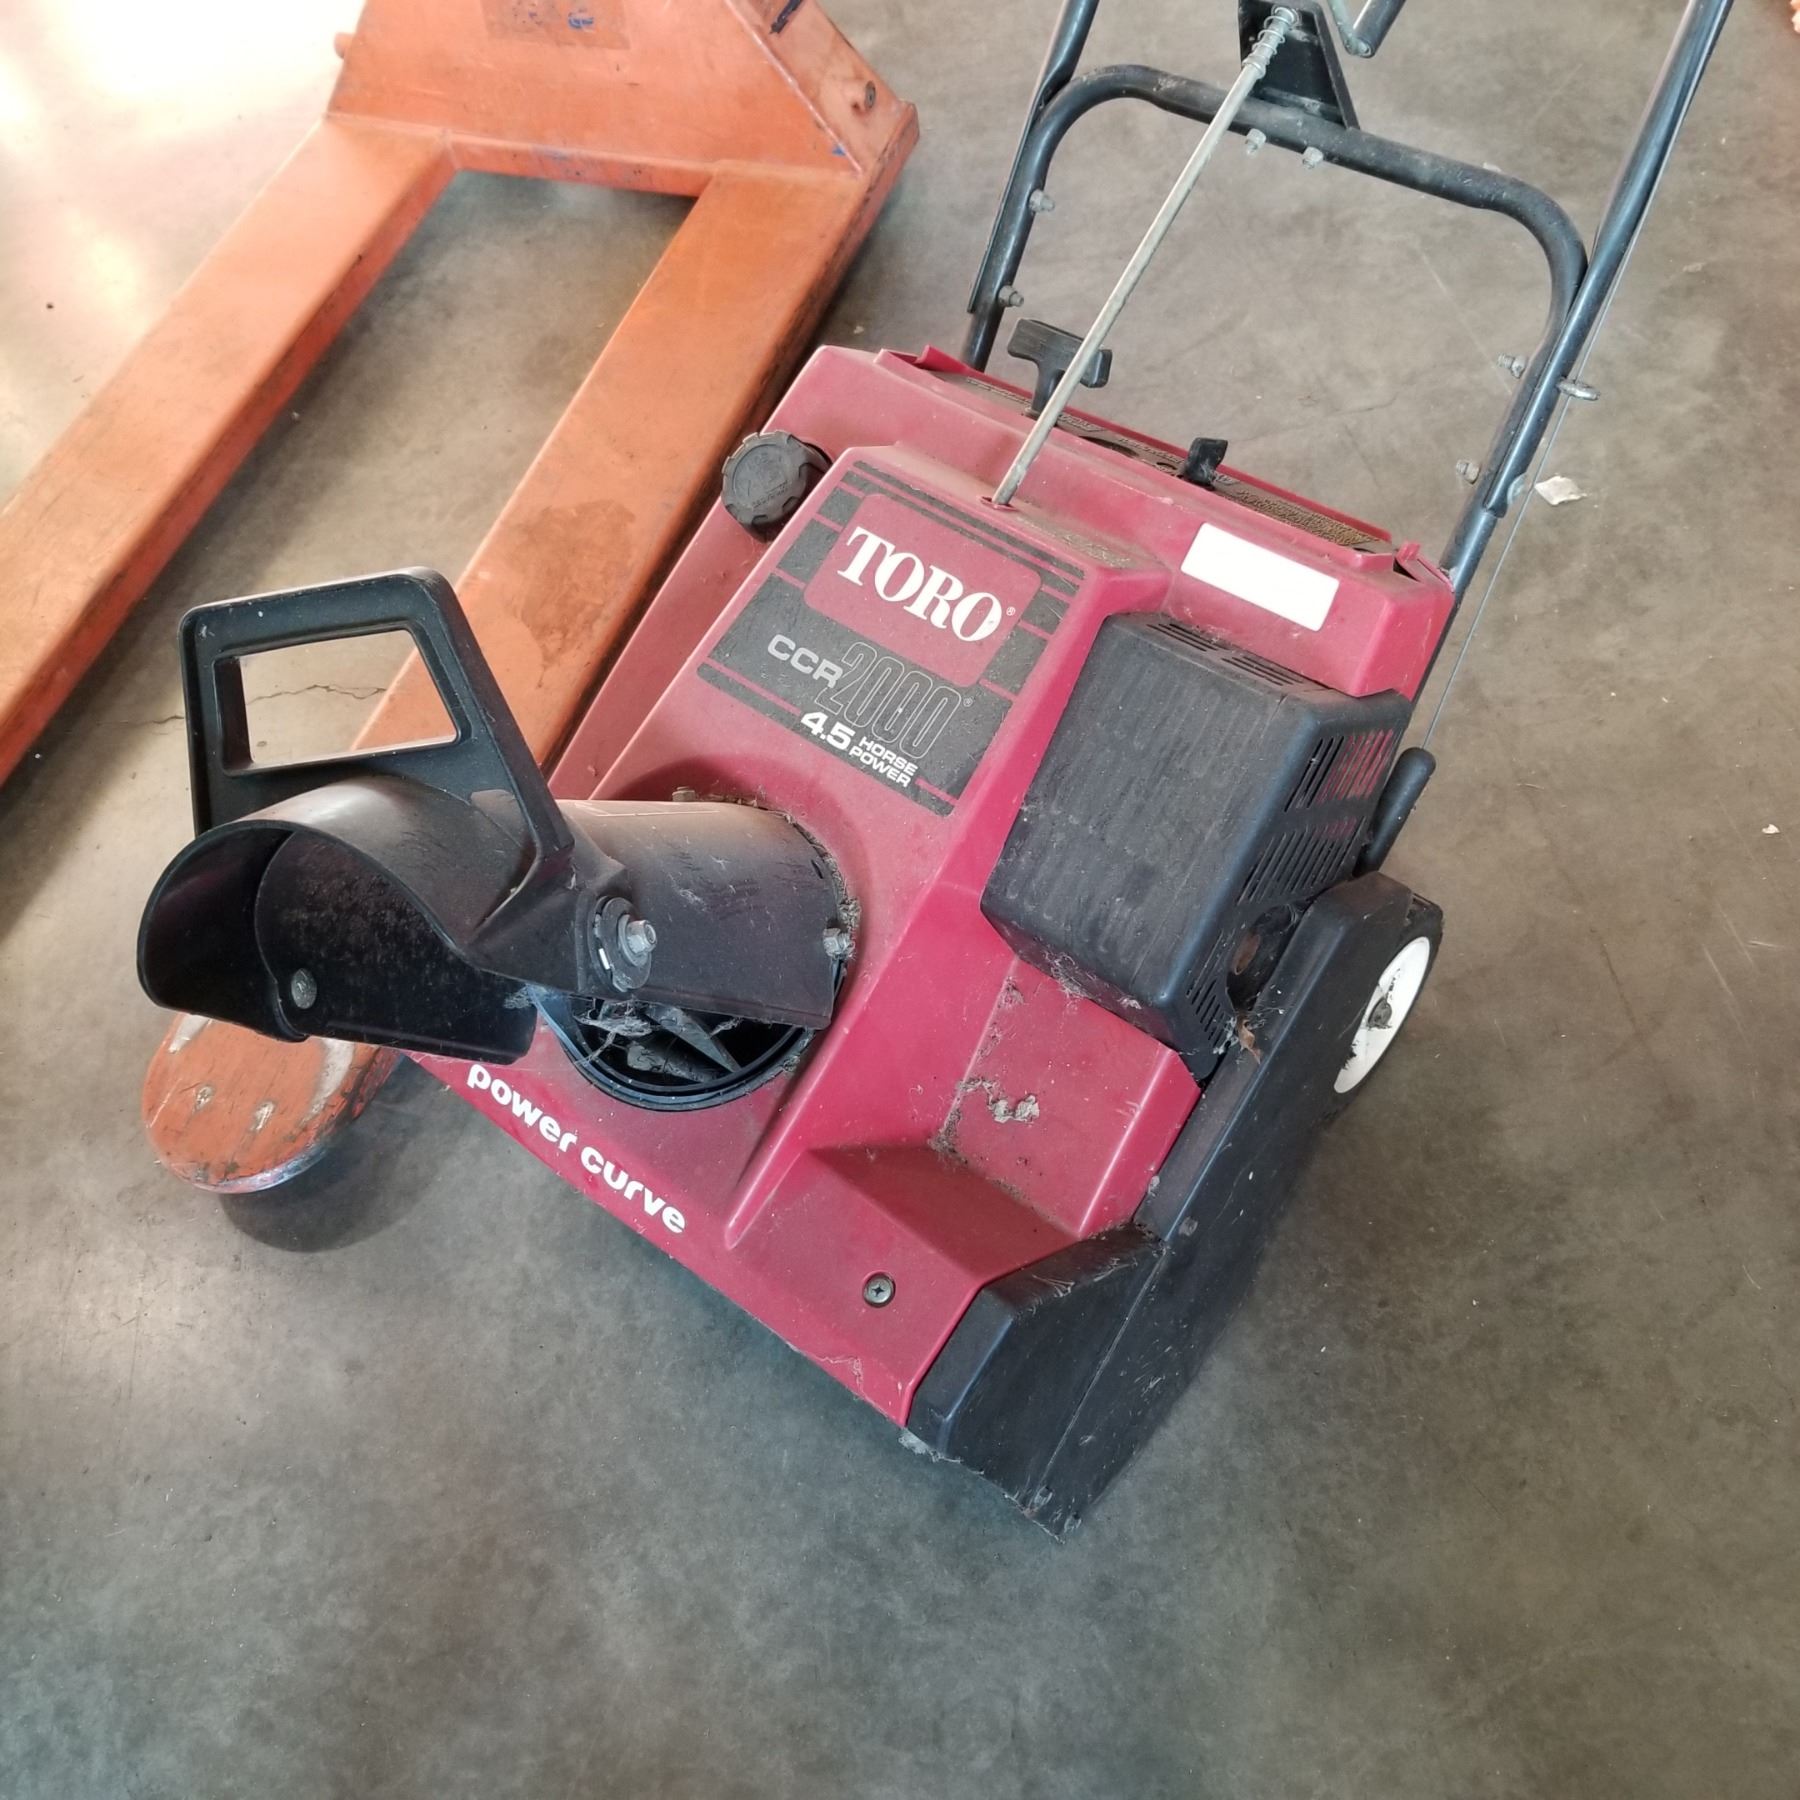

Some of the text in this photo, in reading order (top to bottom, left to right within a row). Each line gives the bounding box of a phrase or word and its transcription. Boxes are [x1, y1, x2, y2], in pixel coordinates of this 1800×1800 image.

[767, 634, 962, 760] CCR 2000
[800, 711, 856, 751] 4.5
[848, 745, 912, 788] POWER
[858, 735, 919, 777] HORSE
[466, 1063, 687, 1234] power curve
